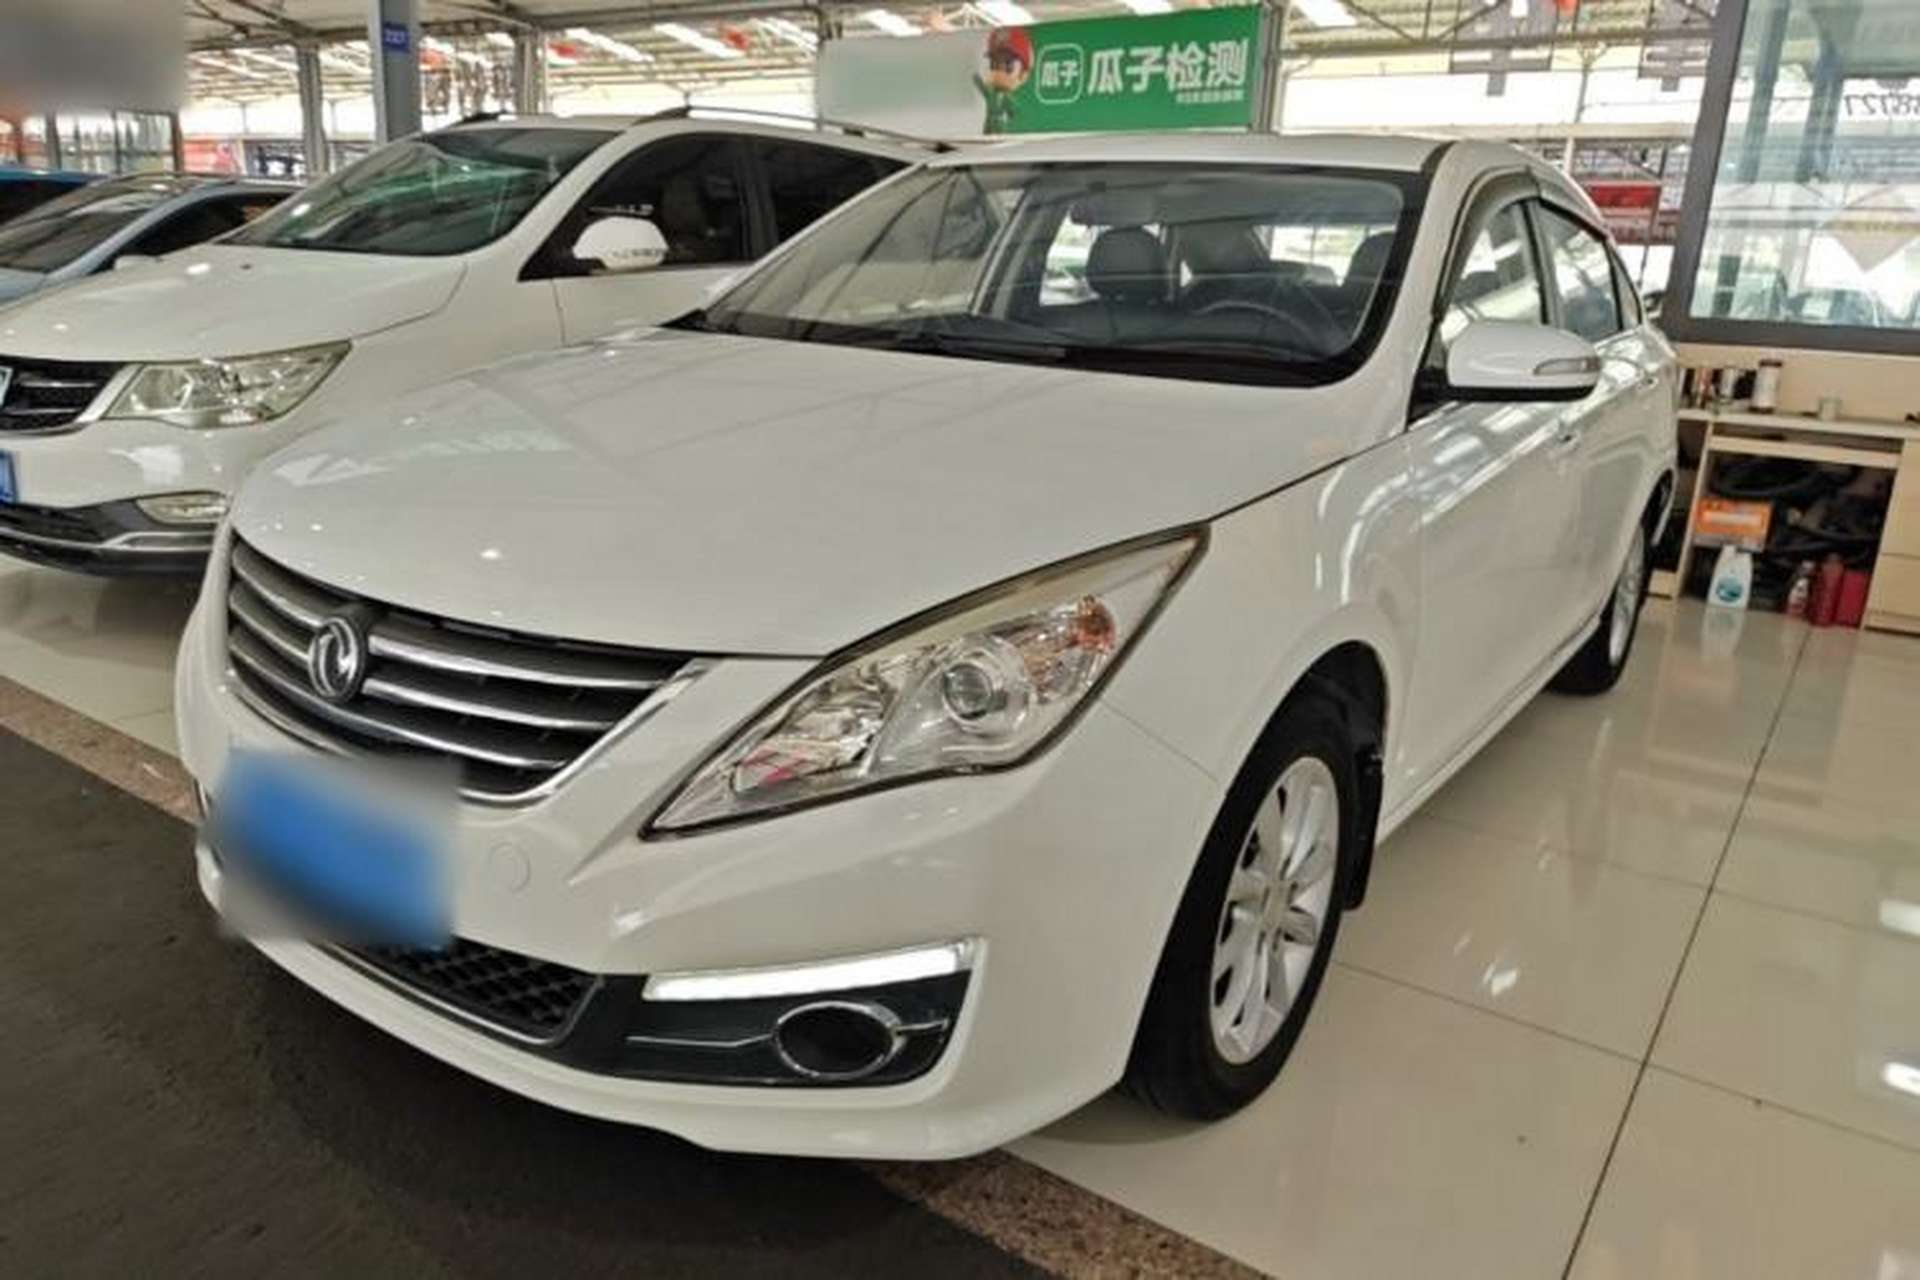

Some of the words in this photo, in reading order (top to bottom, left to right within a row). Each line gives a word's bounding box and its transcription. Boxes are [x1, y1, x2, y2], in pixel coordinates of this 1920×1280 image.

[1041, 60, 1078, 87] 瓜子
[1087, 38, 1249, 95] 瓜子检测
